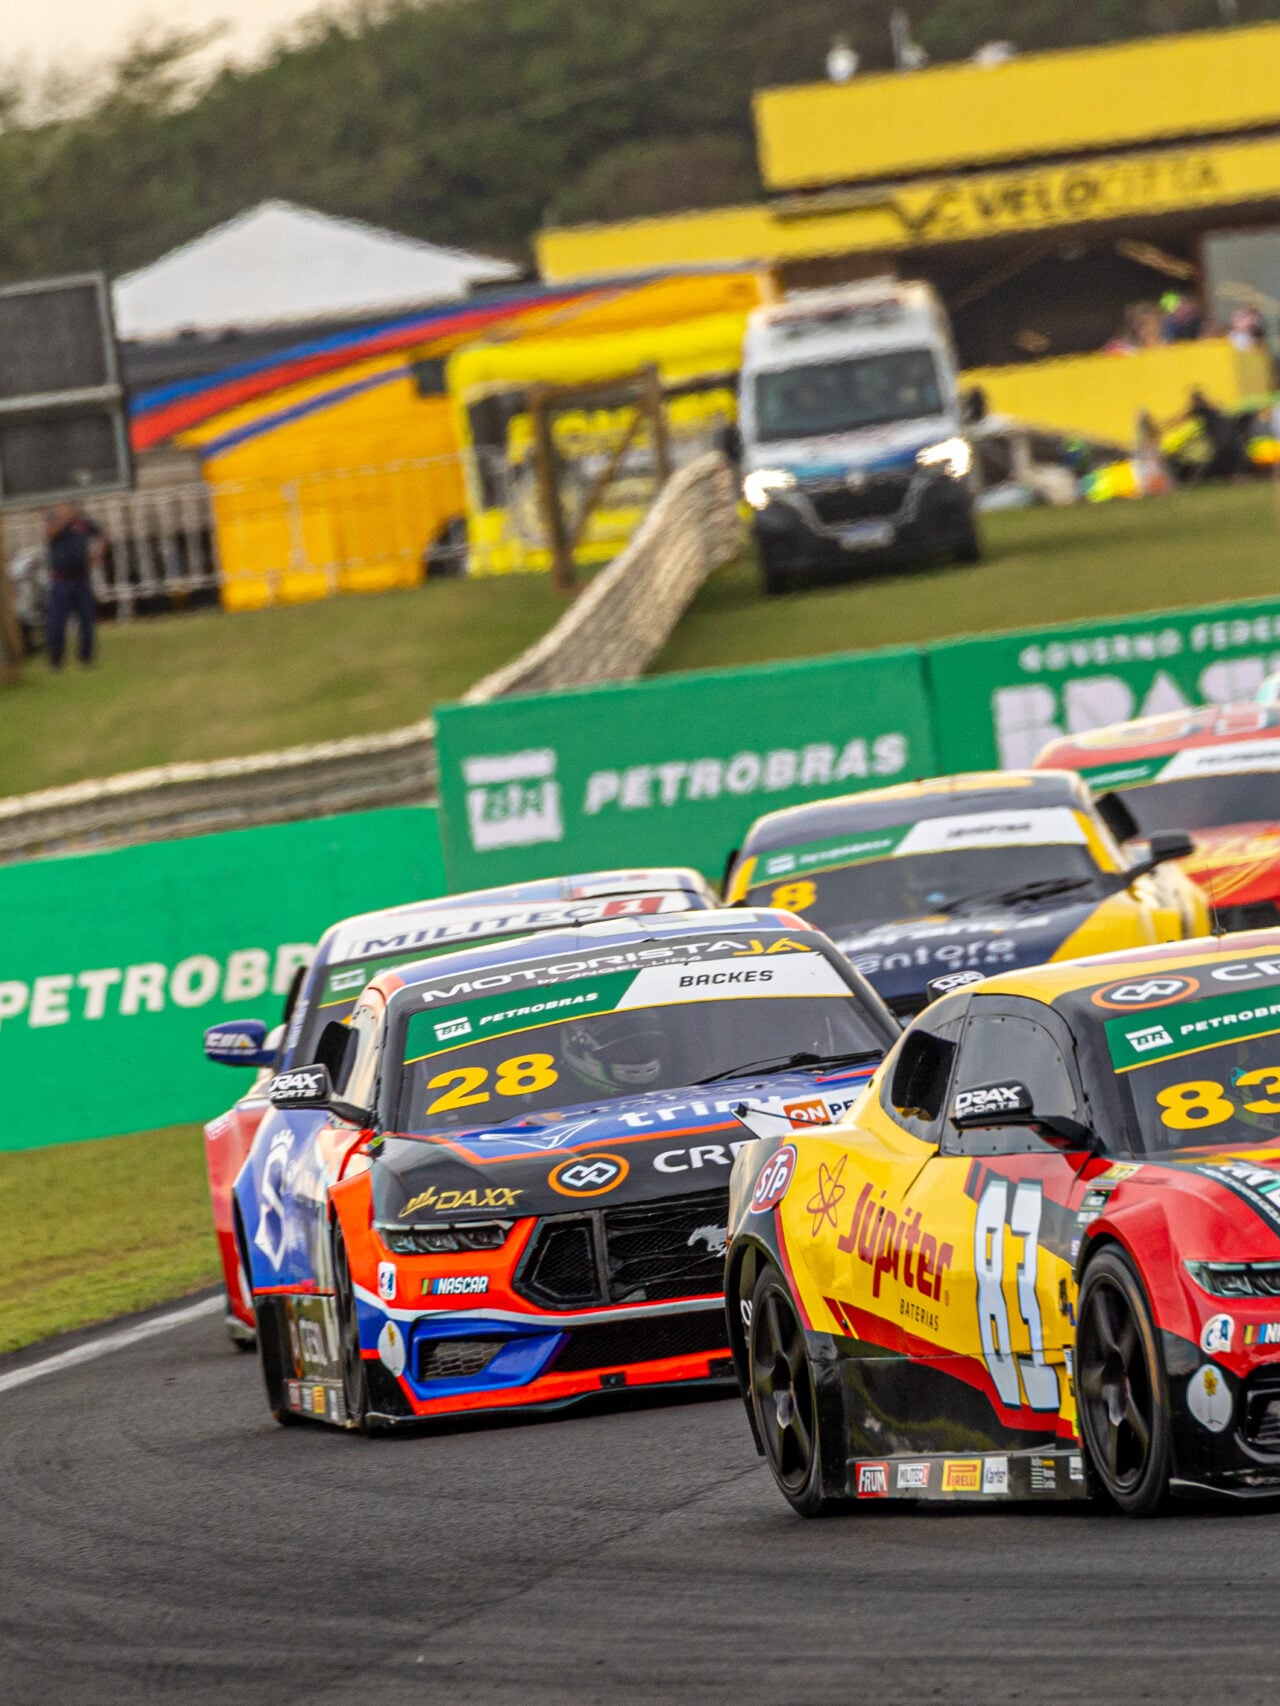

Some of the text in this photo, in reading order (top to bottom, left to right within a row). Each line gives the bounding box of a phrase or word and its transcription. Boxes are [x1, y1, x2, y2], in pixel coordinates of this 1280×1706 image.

[1019, 628, 1182, 673] GOVERNO
[584, 731, 908, 815] PETROBRAS
[770, 881, 817, 913] 8
[362, 898, 645, 954] MILITEC 1
[679, 970, 774, 988] BACKES
[479, 992, 599, 1026] PETROBRAS
[426, 1053, 559, 1115] 28
[955, 1086, 1023, 1111] DRAX
[790, 1105, 826, 1122] ON
[956, 1100, 1020, 1119] SPORTS
[754, 1153, 789, 1205] STP
[435, 1187, 525, 1210] DAXX
[837, 1182, 954, 1302] Júpiter
[437, 1276, 489, 1295] NASCAR
[974, 1178, 1060, 1414] 83
[900, 1298, 939, 1332] BATERIAS
[858, 1465, 888, 1494] FRUM
[946, 1464, 978, 1487] PIRELLI
